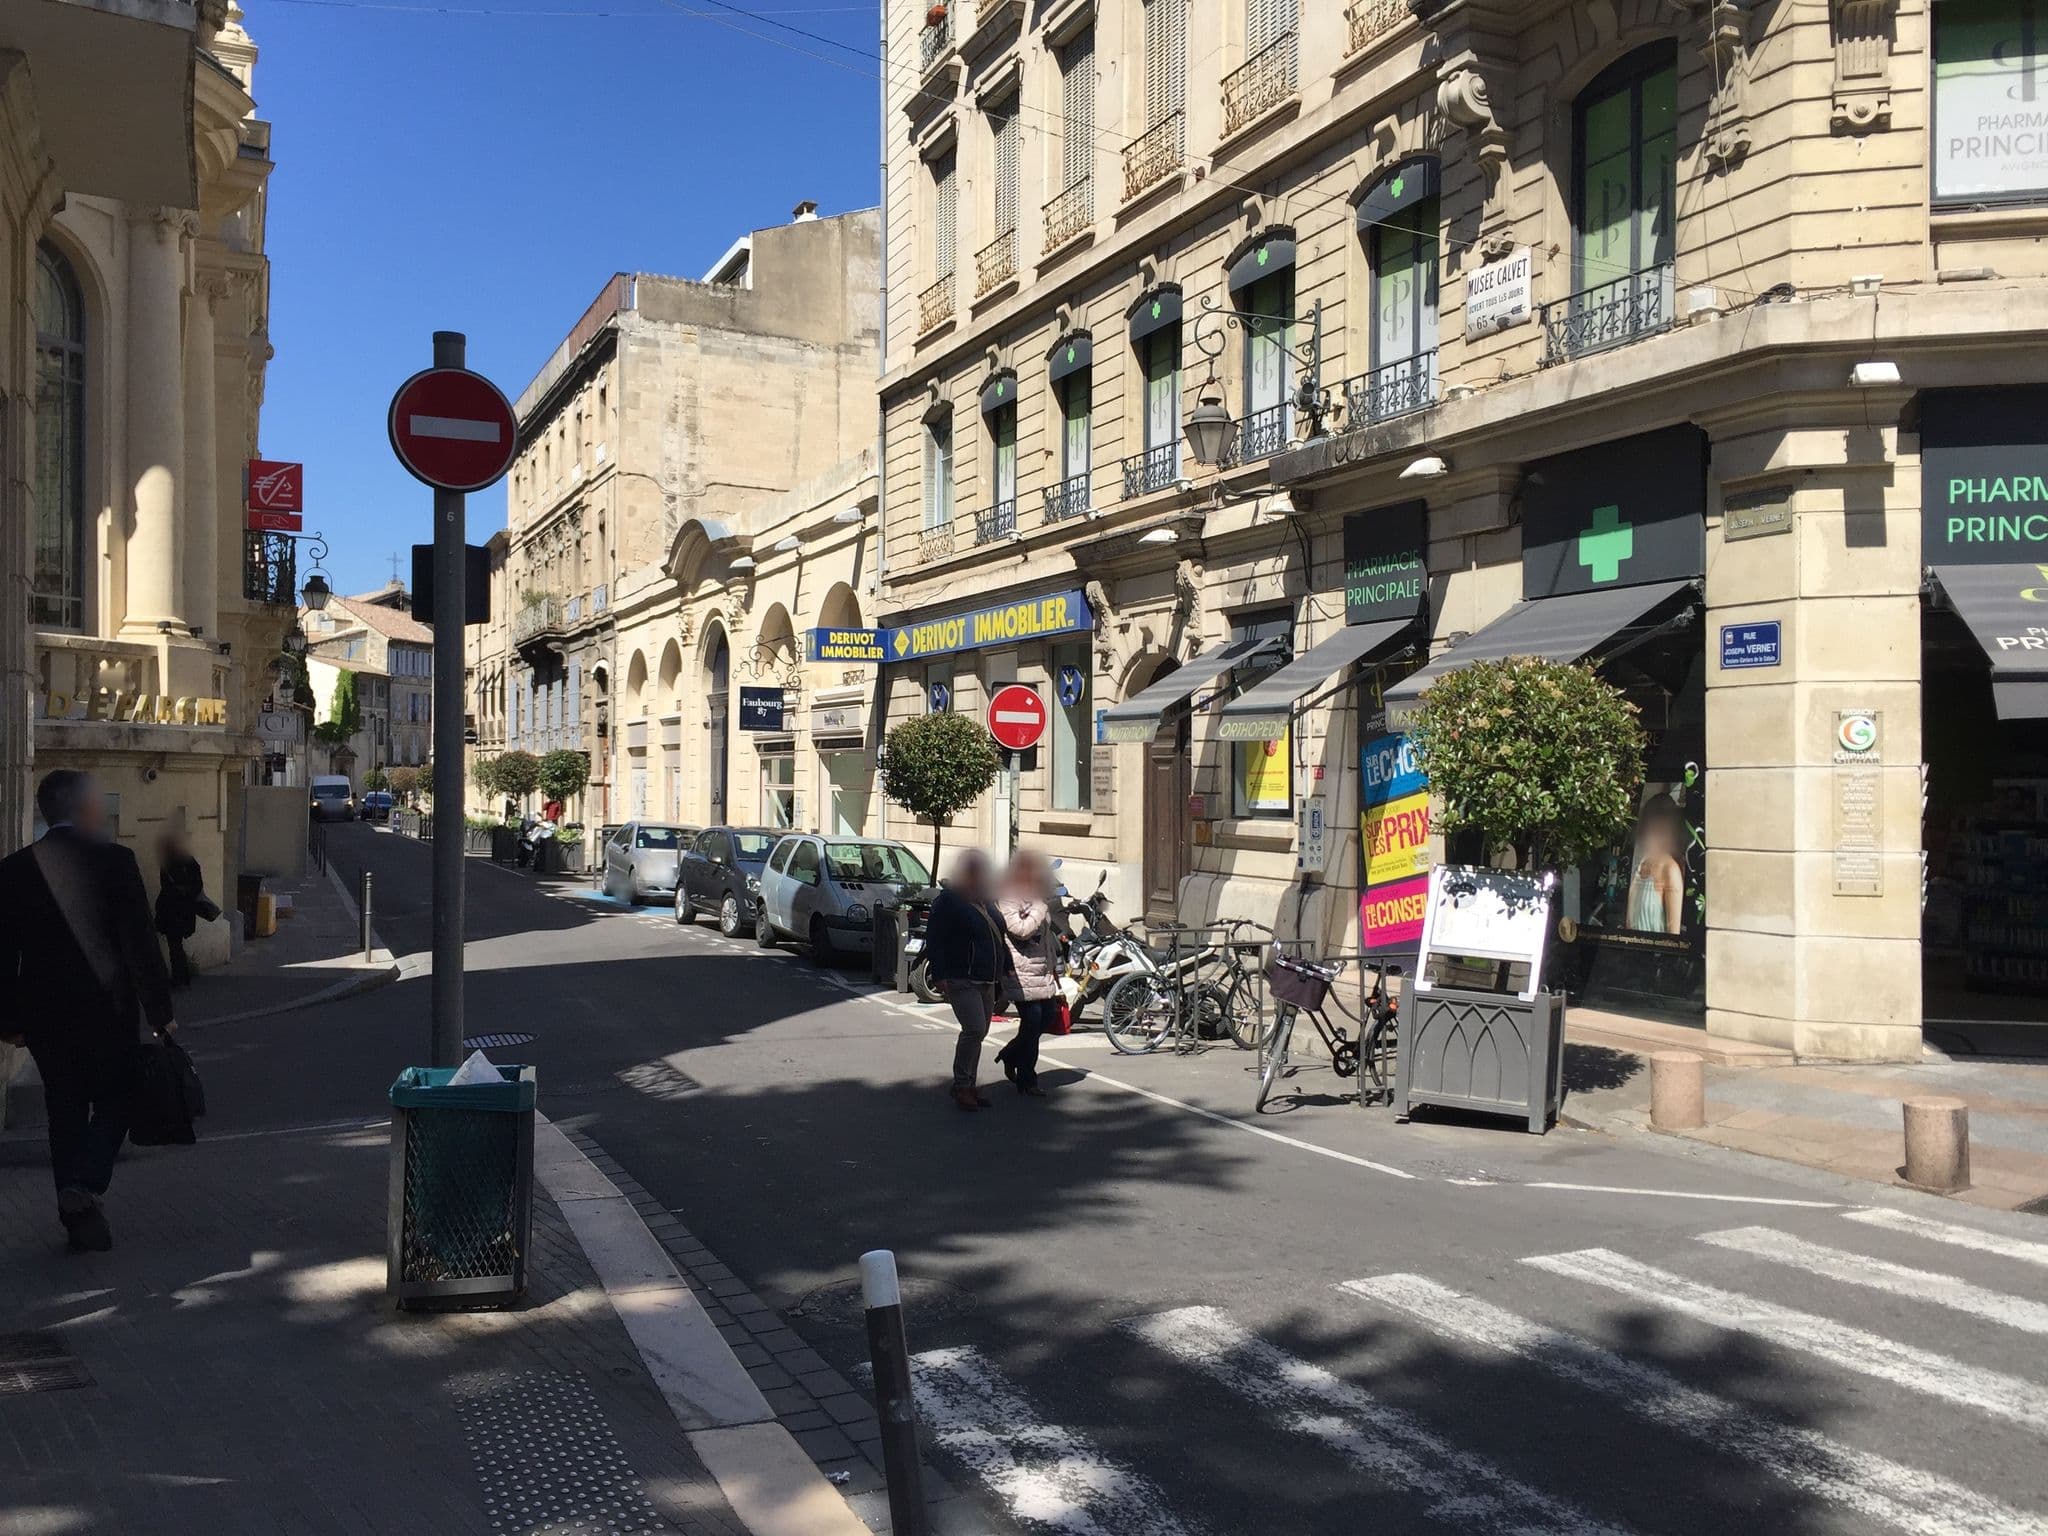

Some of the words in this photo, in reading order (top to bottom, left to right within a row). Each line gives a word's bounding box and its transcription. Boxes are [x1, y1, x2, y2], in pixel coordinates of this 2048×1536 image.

[1950, 132, 2048, 160] PRINCI
[1497, 258, 1527, 285] CALVET
[1476, 315, 1488, 330] 65
[447, 511, 455, 522] 6
[1347, 549, 1419, 580] PHARMACIE
[1347, 578, 1420, 607] PRINCIPALE
[912, 619, 965, 655] DERIVOT
[974, 597, 1067, 644] IMMOBILIER
[829, 631, 876, 645] DERIVOT
[1743, 631, 1757, 641] RUE
[821, 645, 884, 659] IMMOBILIER
[1746, 642, 1777, 654] VERNET
[743, 697, 783, 710] Faubourg
[757, 706, 767, 717] 87
[1106, 725, 1149, 740] NUTRITION
[1219, 720, 1287, 737] ORTHOPEDIE
[1366, 754, 1378, 768] SUR
[1367, 765, 1381, 786] LE
[1380, 742, 1418, 783] CHO
[1366, 820, 1383, 839] SUR
[1368, 837, 1386, 857] LES
[1384, 806, 1429, 853] PRIX
[1367, 913, 1378, 929] LE
[1376, 893, 1427, 928] CONSEI
